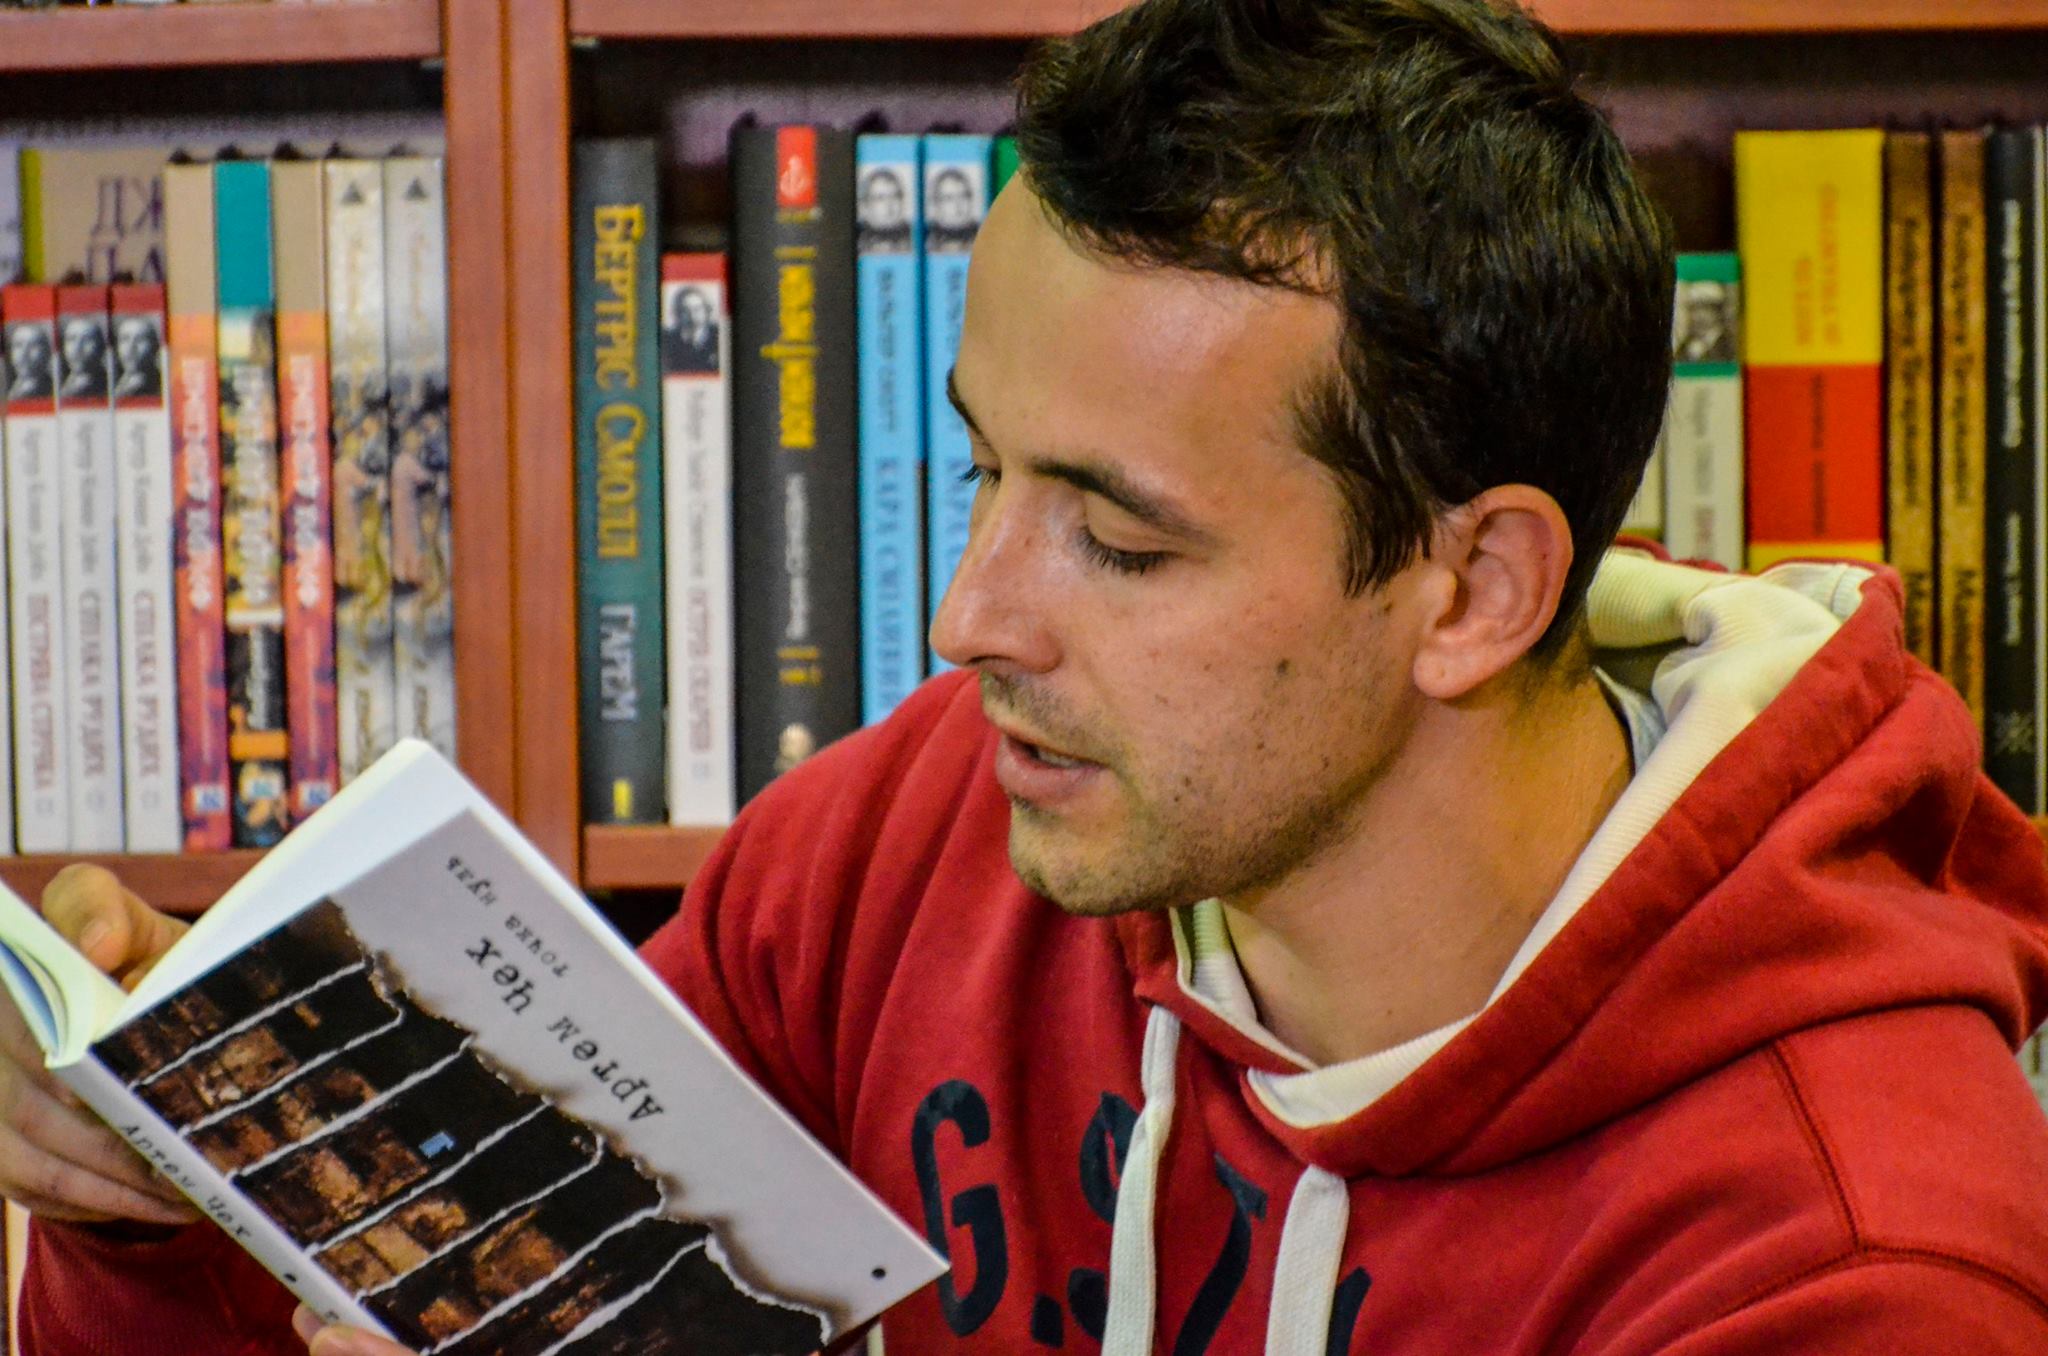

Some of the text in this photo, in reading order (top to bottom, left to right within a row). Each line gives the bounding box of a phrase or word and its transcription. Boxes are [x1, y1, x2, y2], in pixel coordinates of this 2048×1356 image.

[447, 855, 570, 979] точка нуль
[464, 936, 664, 1122] Артем Чех
[207, 1195, 252, 1238] Чех
